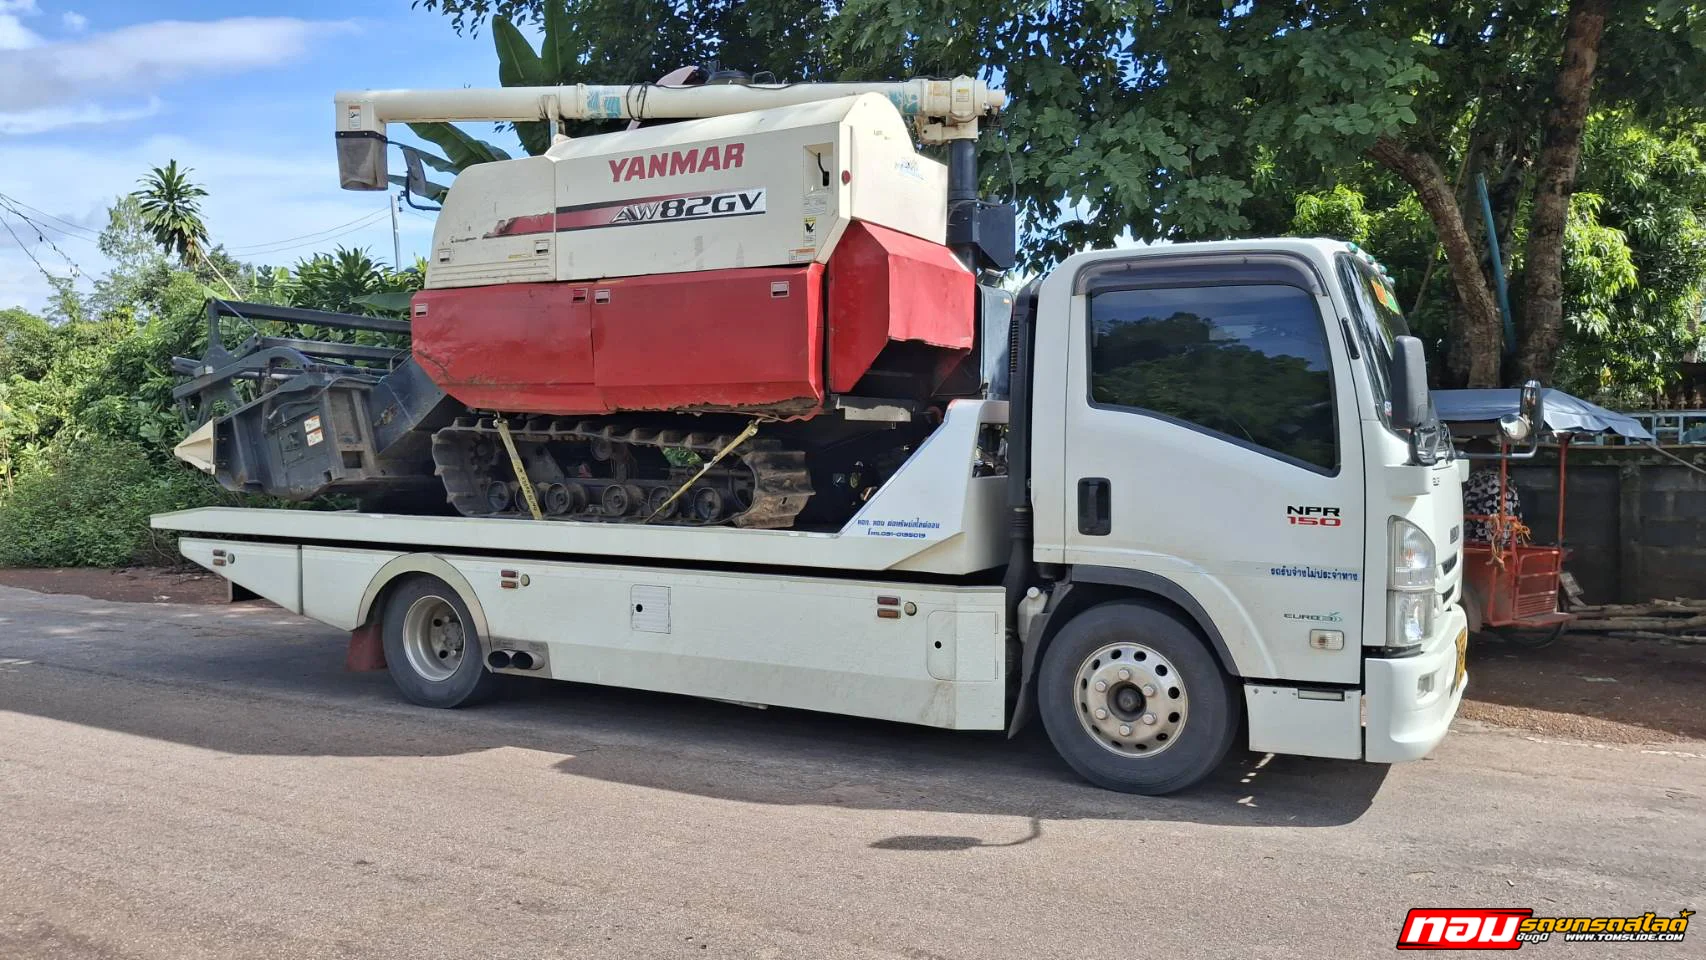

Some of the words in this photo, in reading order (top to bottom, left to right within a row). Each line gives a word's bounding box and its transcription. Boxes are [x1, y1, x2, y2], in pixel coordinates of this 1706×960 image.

[608, 143, 745, 183] YANMAR
[610, 191, 762, 223] AW82GV
[1287, 505, 1341, 516] NPR
[1286, 516, 1342, 527] 150
